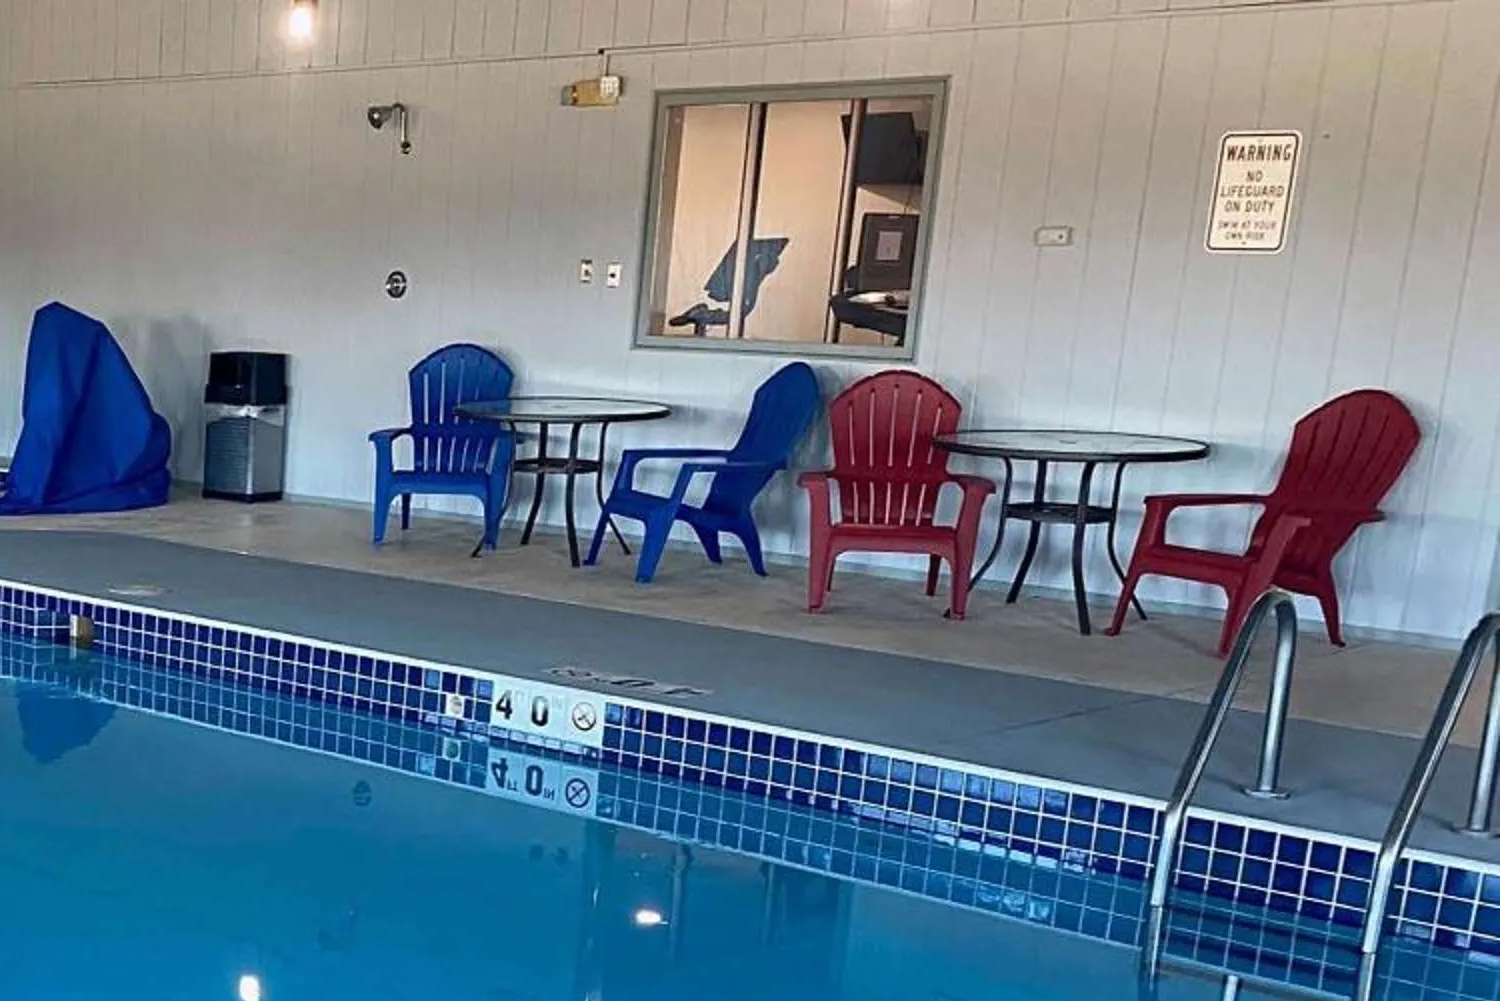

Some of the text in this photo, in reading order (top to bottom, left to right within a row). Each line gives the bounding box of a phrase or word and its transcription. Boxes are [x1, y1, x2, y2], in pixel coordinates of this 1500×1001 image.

[1226, 144, 1293, 161] WARNING
[1246, 170, 1264, 182] NO
[1219, 185, 1285, 198] LIFEGUARD
[1224, 200, 1275, 213] ON DUTY
[495, 690, 513, 720] 4
[531, 695, 549, 727] 0
